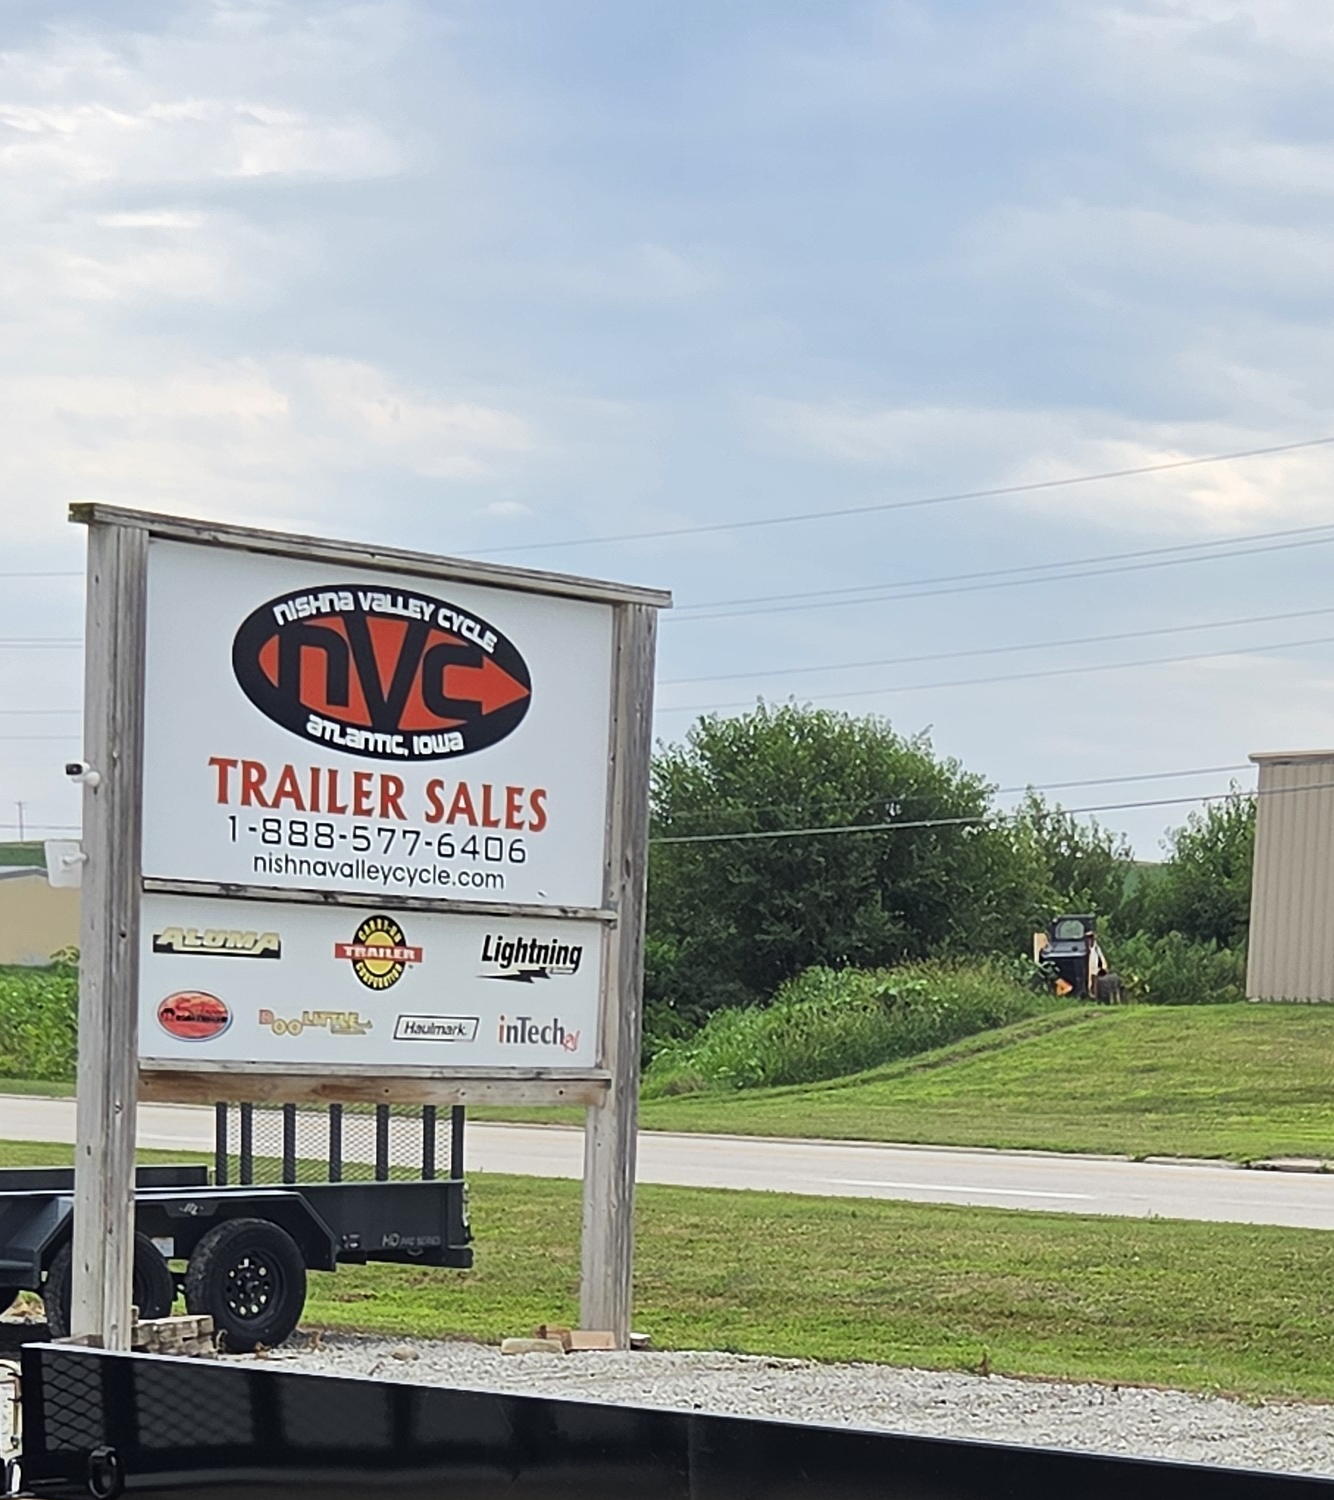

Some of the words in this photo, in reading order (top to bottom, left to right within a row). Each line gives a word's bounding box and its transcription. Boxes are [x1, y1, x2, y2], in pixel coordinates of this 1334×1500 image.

[358, 591, 435, 622] VALLEY
[437, 608, 498, 654] CYCLE
[208, 756, 408, 821] TRAILER
[424, 778, 548, 833] SALES
[228, 815, 527, 864] 1-888-577-6406
[253, 852, 505, 890] nishnavalleycycle.com
[156, 926, 281, 951] ALUMA
[343, 945, 415, 960] TRAILER
[481, 934, 583, 974] Lightning
[403, 1021, 467, 1037] Haulmark
[499, 1015, 564, 1045] inTech
